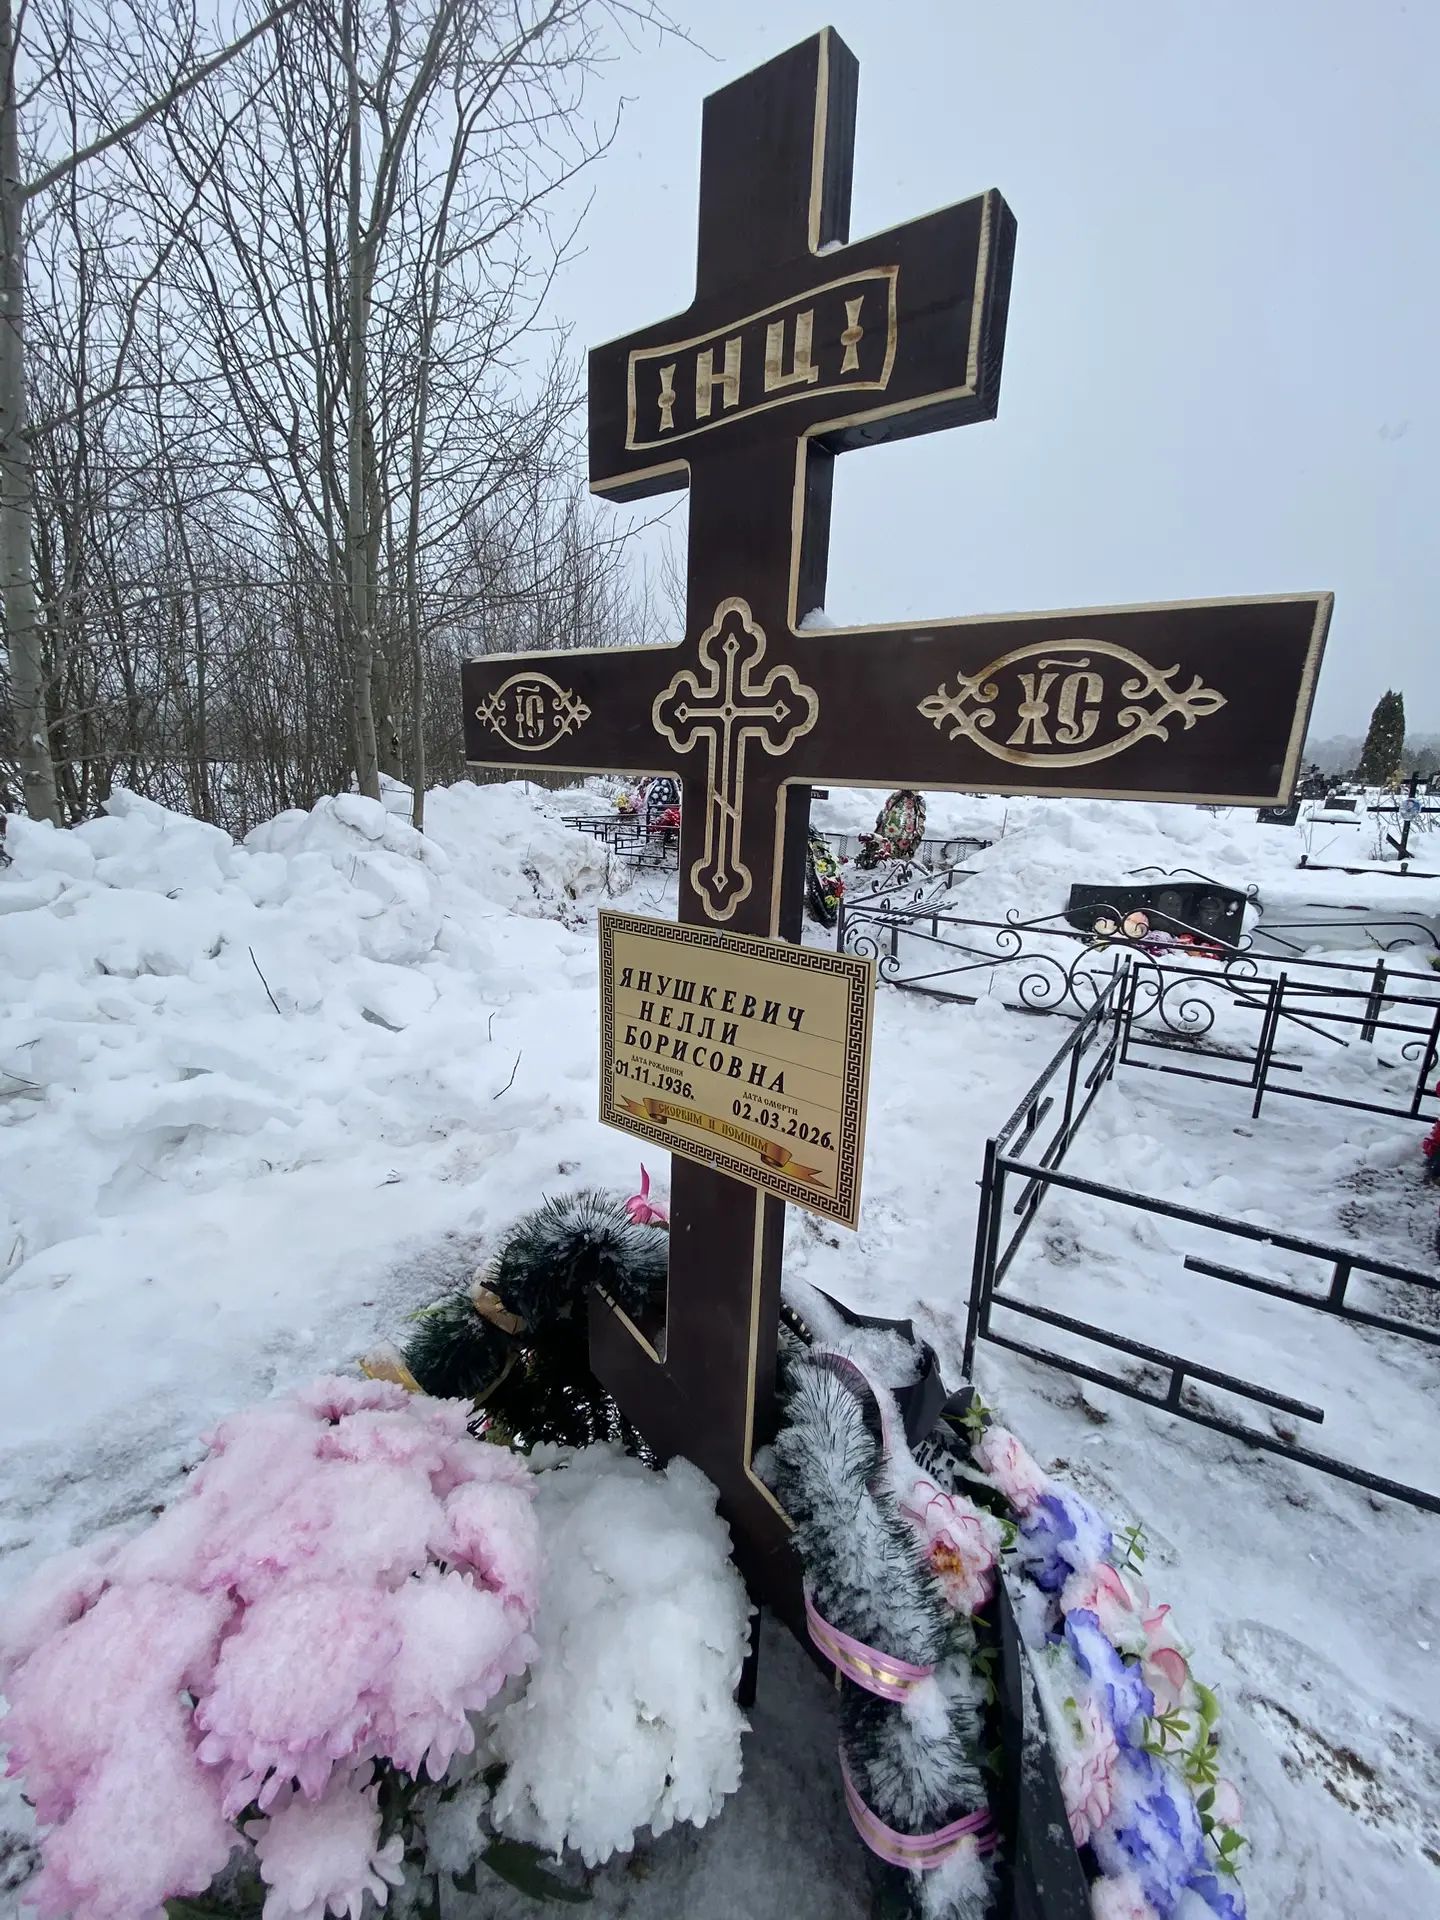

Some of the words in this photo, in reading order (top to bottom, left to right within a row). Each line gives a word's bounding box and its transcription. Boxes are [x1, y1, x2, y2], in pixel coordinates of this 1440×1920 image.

[619, 967, 805, 1032] ЯНУШКЕВИЧ
[638, 1000, 738, 1046] НЕЛЛИ
[615, 1059, 695, 1100] 01.11.1936.
[624, 1024, 785, 1094] БОРИСОВНА
[658, 1103, 702, 1126] СКОРБИМ
[721, 1123, 768, 1153] ПОМНИМ
[732, 1099, 835, 1151] 02.03.2026.
[742, 1091, 763, 1104] ДАТА
[764, 1098, 798, 1116] СМЕРТИ
